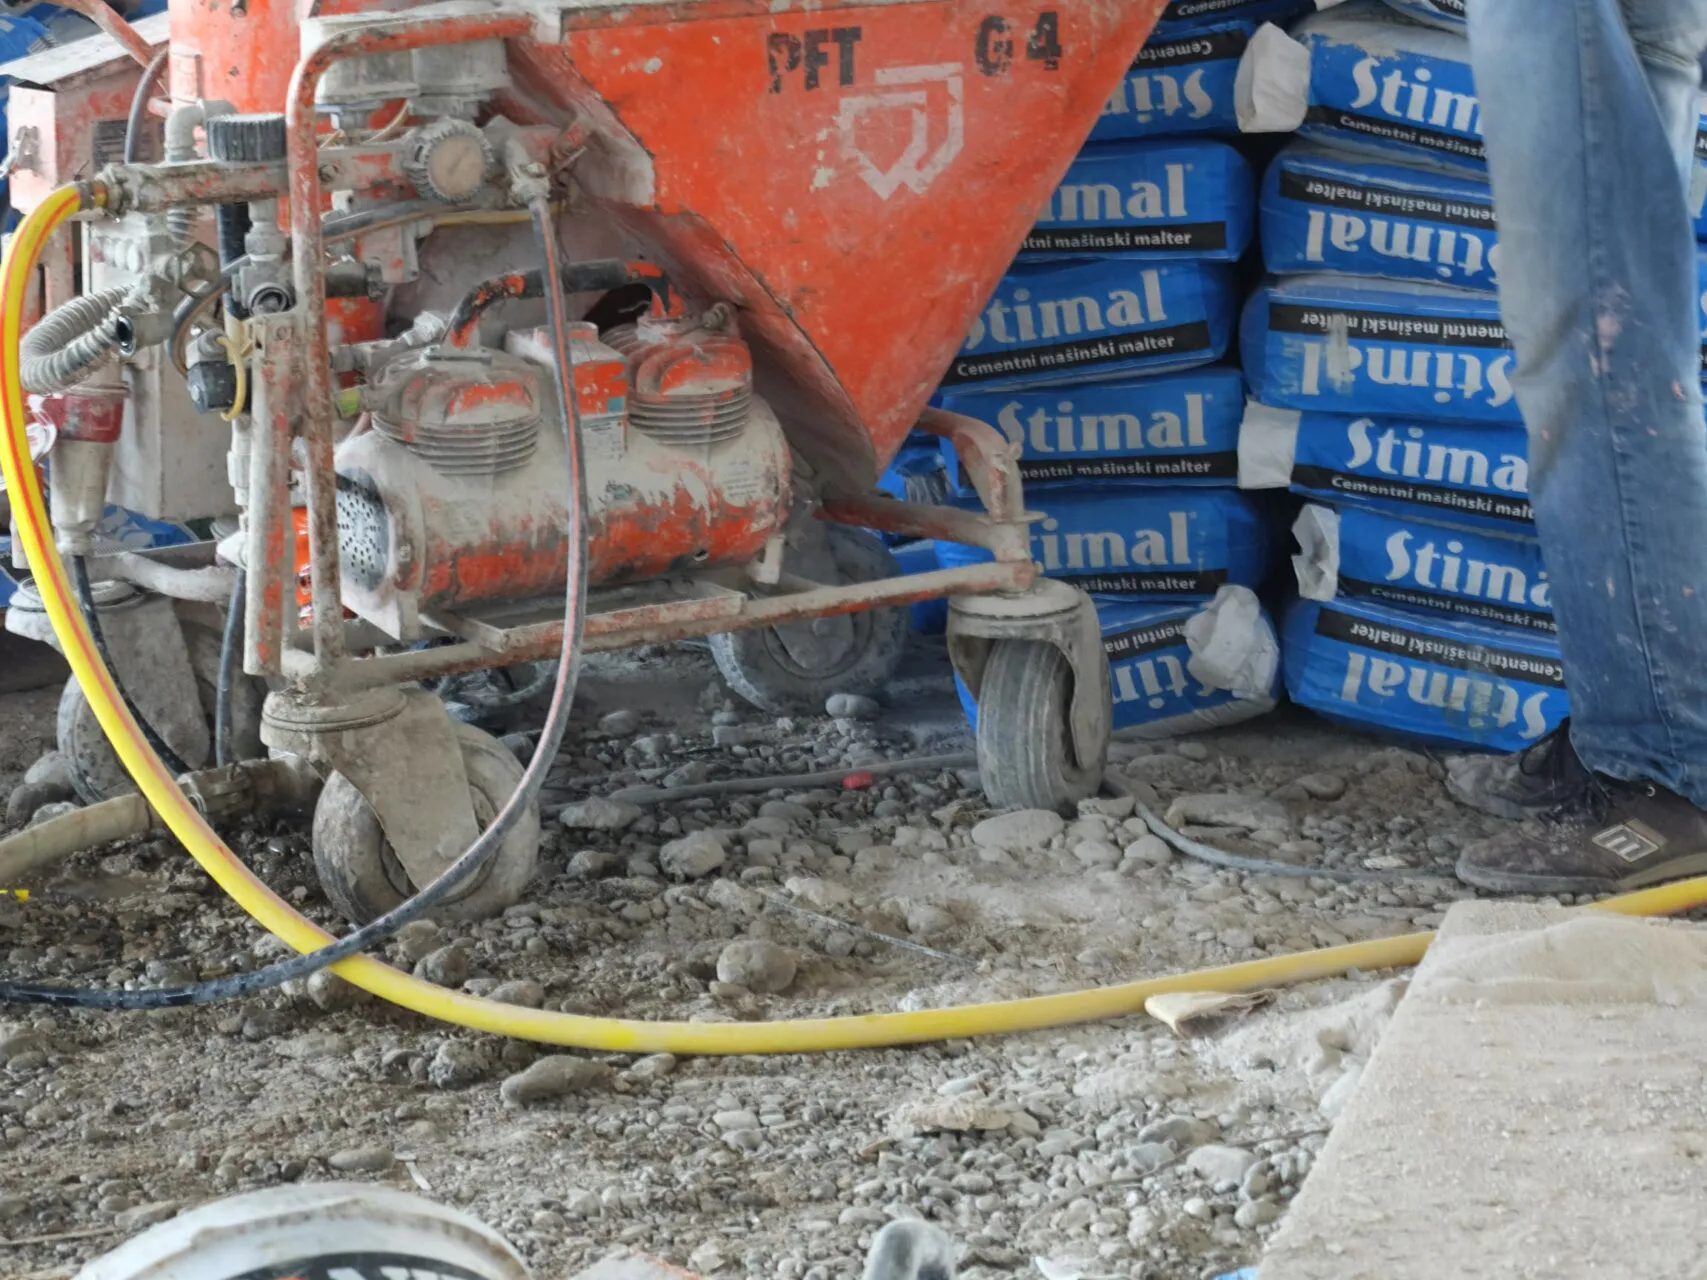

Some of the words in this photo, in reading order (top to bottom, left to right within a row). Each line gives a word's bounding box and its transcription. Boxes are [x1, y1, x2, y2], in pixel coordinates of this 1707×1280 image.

[767, 26, 862, 94] PFT
[1134, 39, 1213, 64] Cementn
[1351, 56, 1484, 136] Stim
[1340, 114, 1418, 143] Cementni
[1420, 133, 1488, 159] mašinsk
[1037, 163, 1188, 222] mal
[1305, 180, 1363, 201] malter
[1365, 190, 1442, 213] mašinski
[1054, 231, 1131, 249] mašinski
[1134, 230, 1192, 245] malter
[1362, 317, 1440, 336] mašinski
[957, 353, 1037, 378] Cementni
[1039, 341, 1116, 367] mašinski
[1119, 334, 1176, 355] malter
[1077, 460, 1151, 477] mašinski
[1154, 458, 1212, 474] malter
[1345, 417, 1529, 494] Stima
[1331, 474, 1414, 500] Cementni
[1416, 488, 1493, 513] mašinski
[1030, 511, 1192, 571] imal
[1140, 575, 1197, 590] malter
[1384, 530, 1553, 609] Stima
[1370, 586, 1451, 610] Cementni
[1454, 601, 1530, 627] mašinski
[1350, 622, 1407, 646] malter
[1408, 635, 1483, 662] mašinski
[1484, 648, 1564, 681] Cementni
[1341, 650, 1549, 740] Stimal
